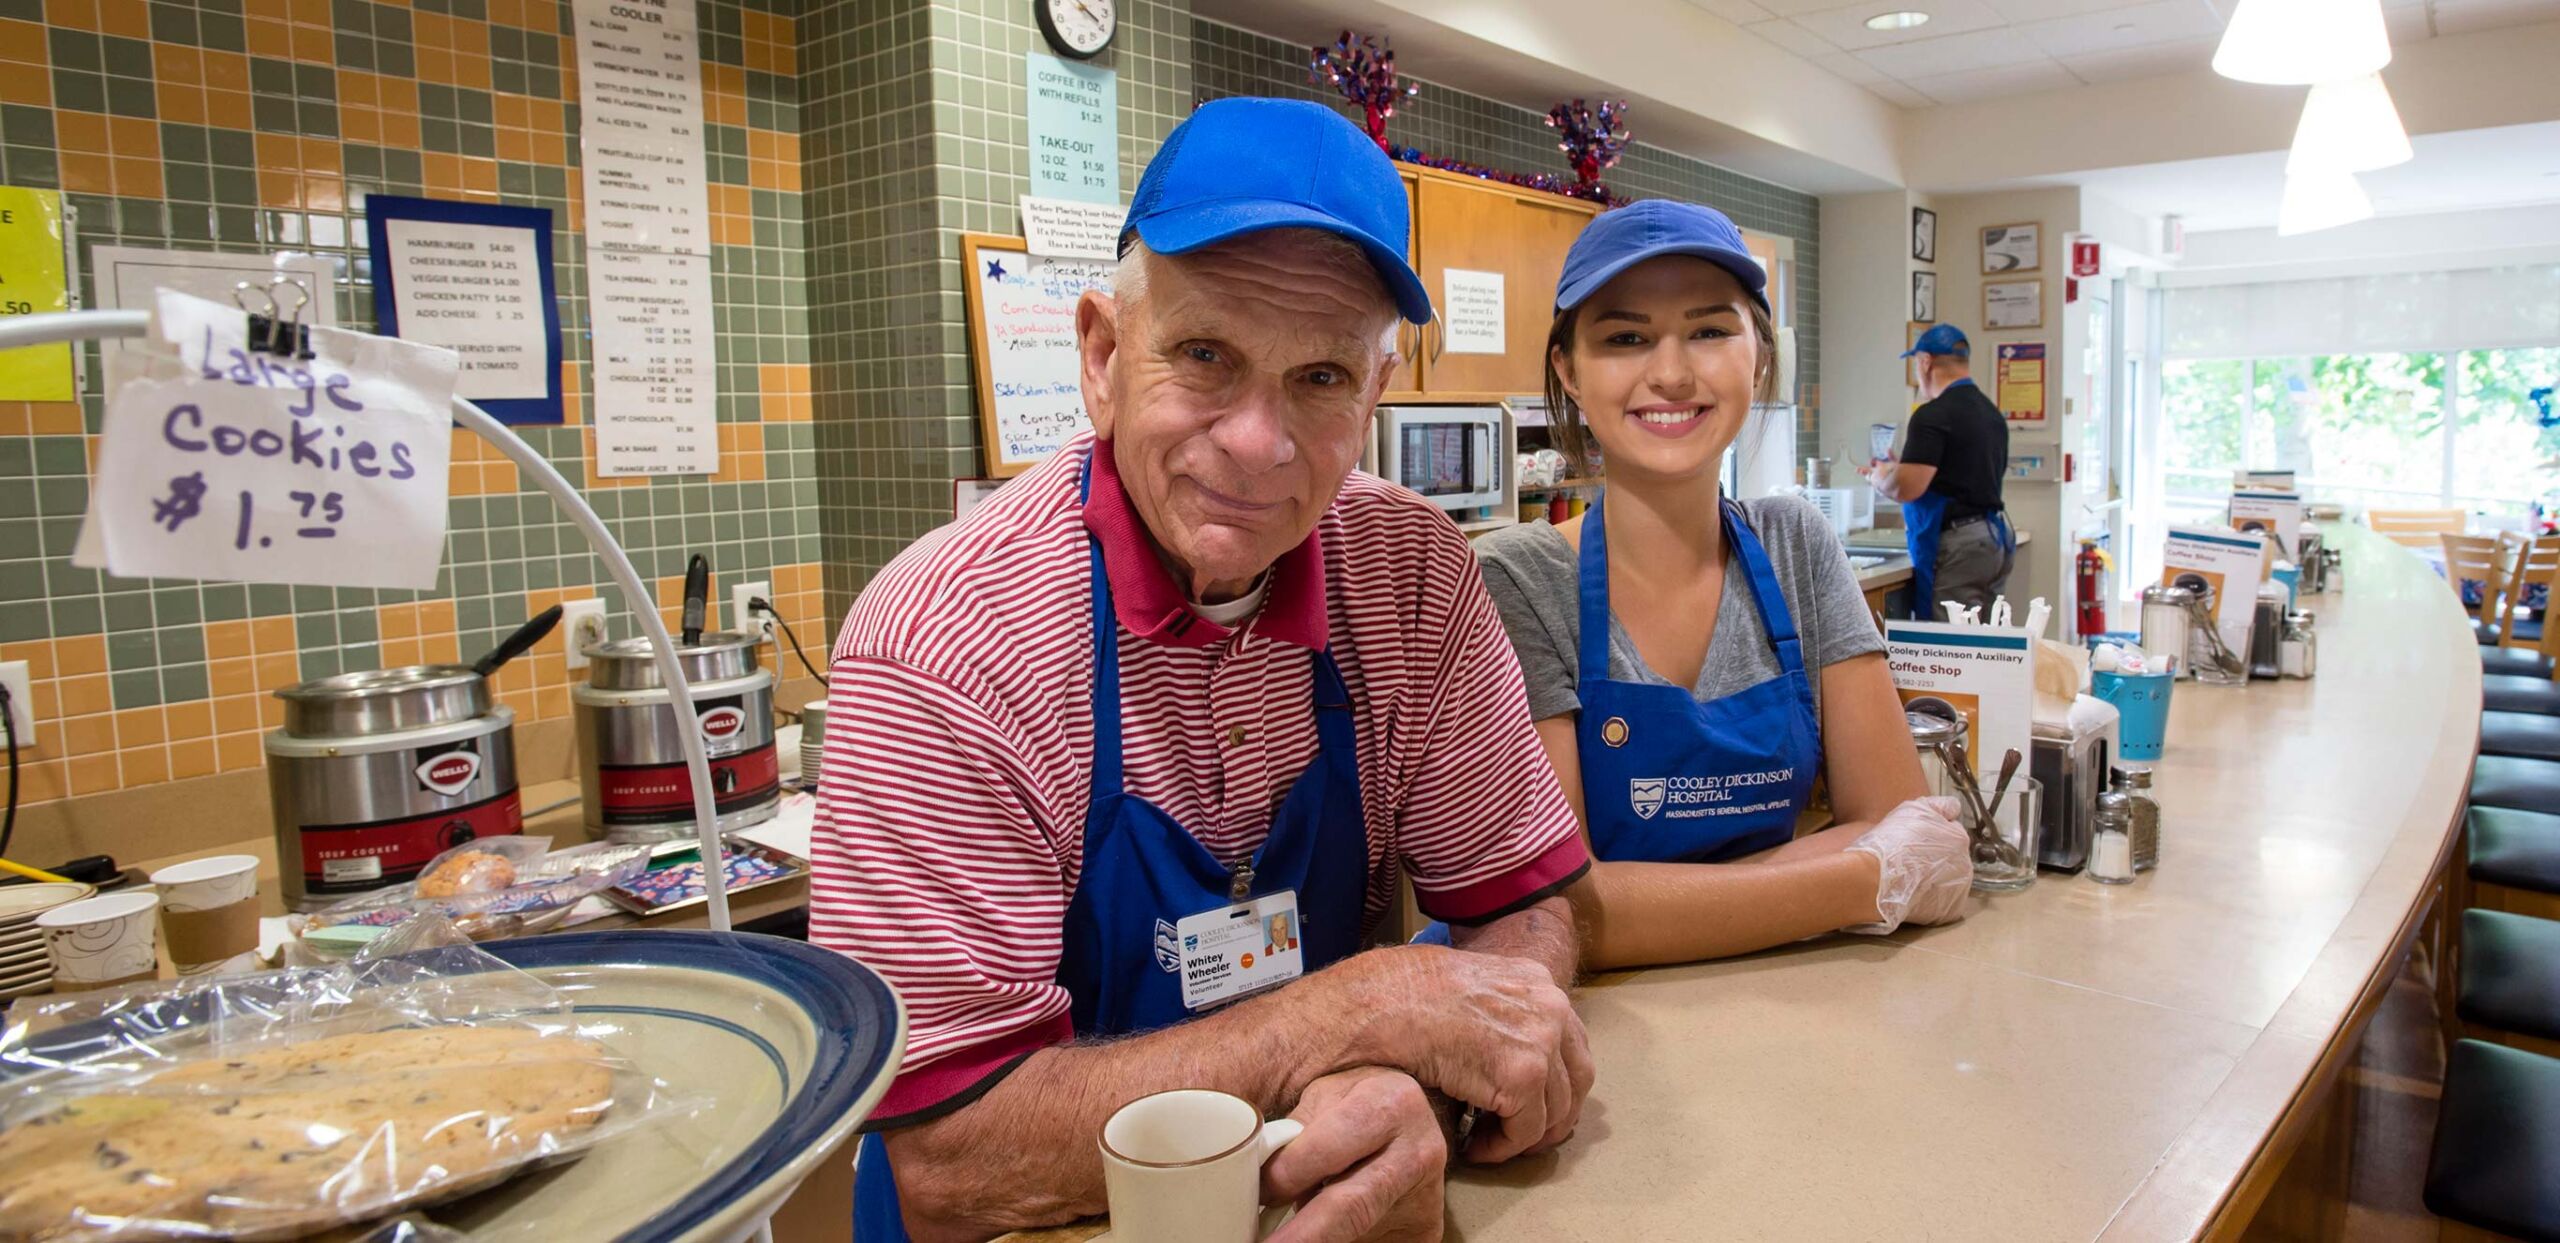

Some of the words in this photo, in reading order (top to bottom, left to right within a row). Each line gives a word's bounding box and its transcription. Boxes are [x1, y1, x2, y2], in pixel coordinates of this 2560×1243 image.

[610, 6, 663, 24] COOLER
[590, 20, 604, 28] ALL
[594, 61, 630, 72] VERMONT
[633, 67, 659, 77] WATER
[1039, 71, 1075, 87] COFFEE
[1039, 88, 1062, 100] WITH
[1064, 92, 1100, 108] REFILLS
[656, 105, 682, 114] WATER
[613, 119, 631, 127] ICED
[633, 121, 648, 129] TEA
[1082, 111, 1102, 123] $1.25
[1040, 135, 1094, 155] TAKE-OUT
[1041, 154, 1050, 164] 12
[1083, 160, 1104, 172] $1.50
[1042, 170, 1051, 179] 16
[1084, 176, 1105, 188] $1.75
[600, 200, 629, 208] STRING
[1030, 203, 1053, 212] Before
[1056, 206, 1082, 216] Placing
[1083, 209, 1100, 217] Your
[601, 221, 633, 229] YOGURT
[1033, 216, 1055, 224] Please
[1058, 218, 1082, 226] Inform
[1084, 220, 1100, 228] Your
[1037, 227, 1044, 235] If
[1051, 229, 1075, 237] Person
[408, 240, 474, 250] HAMBURGER
[489, 243, 515, 252] $4.00
[1048, 240, 1062, 248] Has
[409, 257, 487, 268] CHEESEBURGER
[491, 261, 517, 270] $4.25
[411, 274, 448, 283] VEGGIE
[452, 276, 490, 285] BURGER
[493, 278, 520, 286] $4.00
[413, 291, 458, 300] CHICKEN
[461, 293, 490, 302] PATTY
[495, 295, 521, 303] $4.00
[605, 295, 635, 303] COFFEE
[201, 324, 363, 418] Large
[477, 362, 519, 370] TOMATO
[1020, 414, 1052, 425] Corn
[1055, 412, 1075, 427] Dog
[163, 403, 417, 481] Cookies
[2167, 549, 2192, 558] Coffee
[2195, 553, 2216, 562] Shop
[1889, 646, 1920, 657] Cooley
[1922, 649, 1972, 659] Dickinson
[1976, 652, 2023, 664] Auxiliary
[1889, 661, 1926, 673] Coffee
[1930, 665, 1962, 677] Shop
[706, 718, 736, 730] WELLS
[432, 764, 470, 780] WELLS
[1668, 776, 1724, 790] COOLEY
[1725, 768, 1793, 787] DICKINSON
[613, 787, 635, 795] SOUP
[639, 785, 678, 794] COOKER
[1667, 789, 1733, 803] HOSPITAL
[1665, 808, 1715, 818] MASSACHUSETTS
[1717, 806, 1742, 815] GENERAL
[1742, 804, 1766, 813] HOSPITAL
[1768, 799, 1791, 809] AFFILIATE
[319, 851, 346, 859] SOUP
[352, 844, 400, 856] COOKER
[1187, 953, 1223, 969] Whitey
[1188, 962, 1231, 980] Wheeler
[1213, 972, 1232, 980] Services
[1190, 982, 1223, 996] Volunteer
